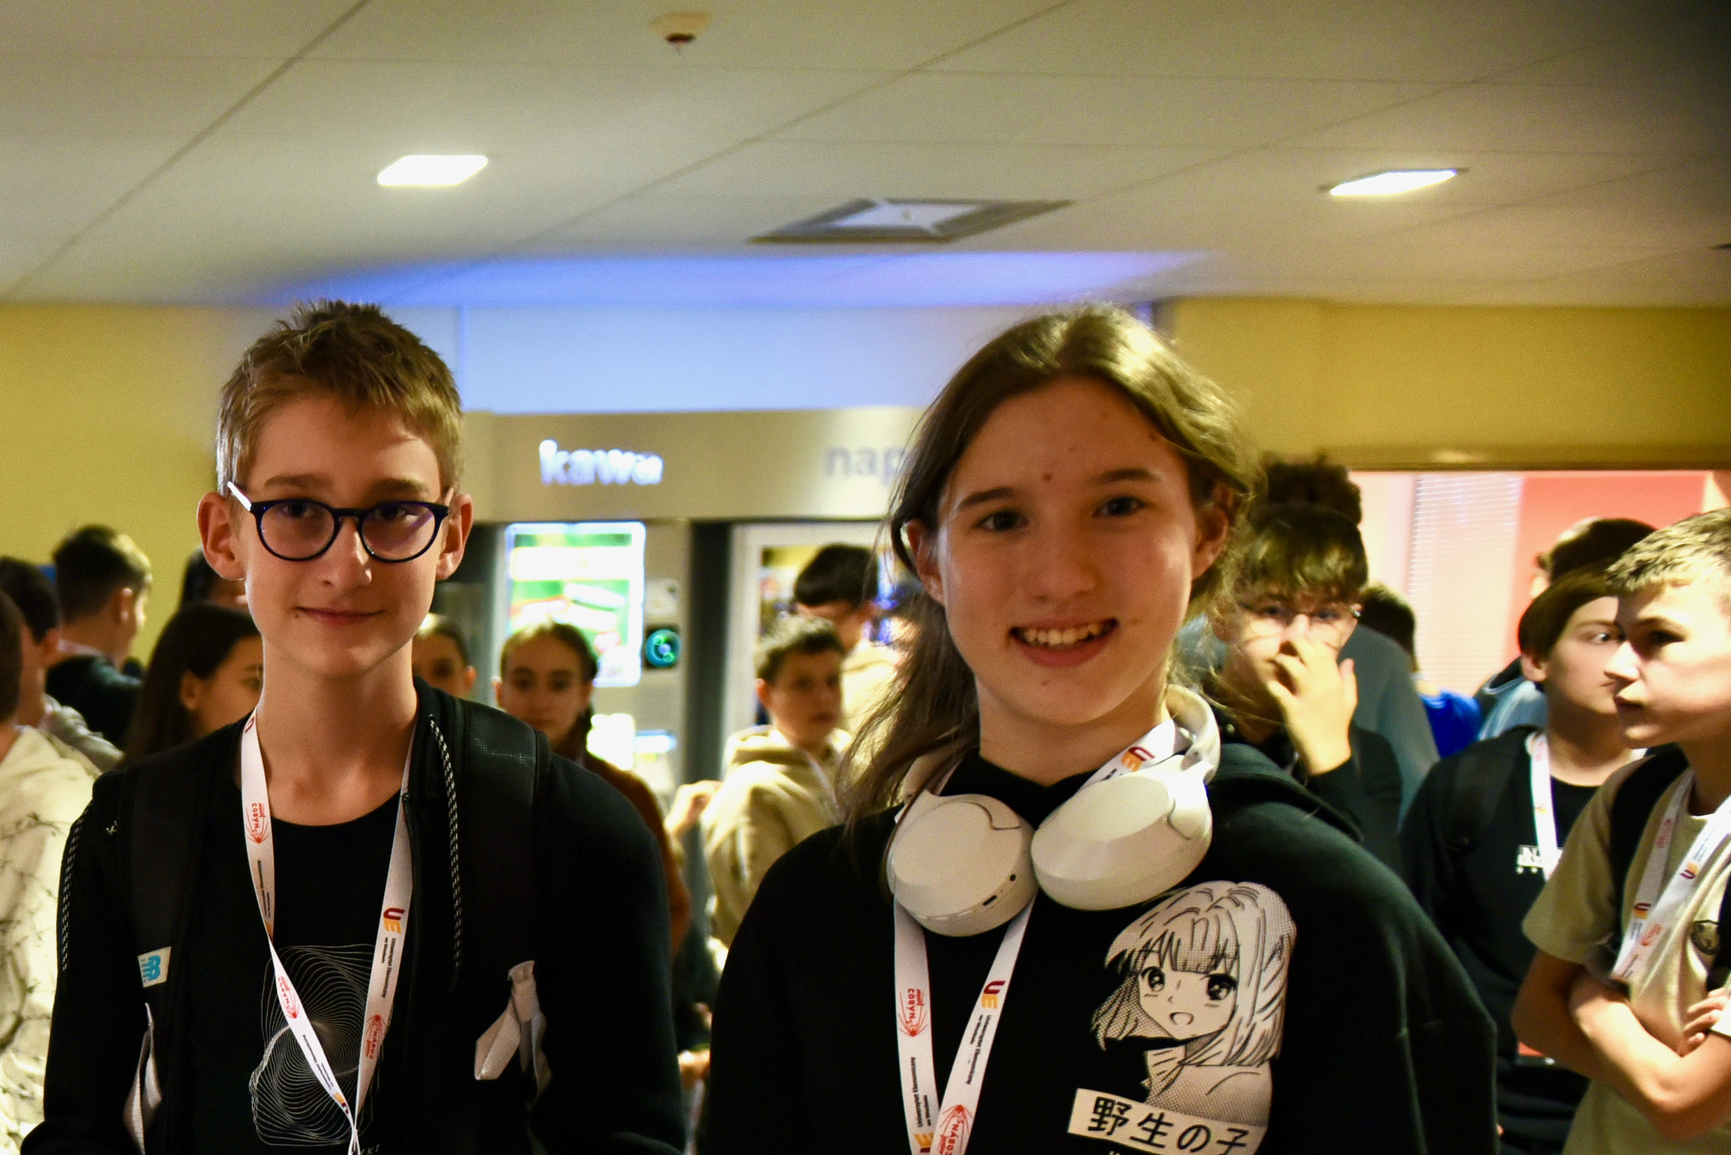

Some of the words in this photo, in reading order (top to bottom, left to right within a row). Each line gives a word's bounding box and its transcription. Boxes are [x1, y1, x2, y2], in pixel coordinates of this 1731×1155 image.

[538, 439, 663, 486] kawa
[383, 907, 406, 934] UE
[981, 980, 1006, 1009] UE
